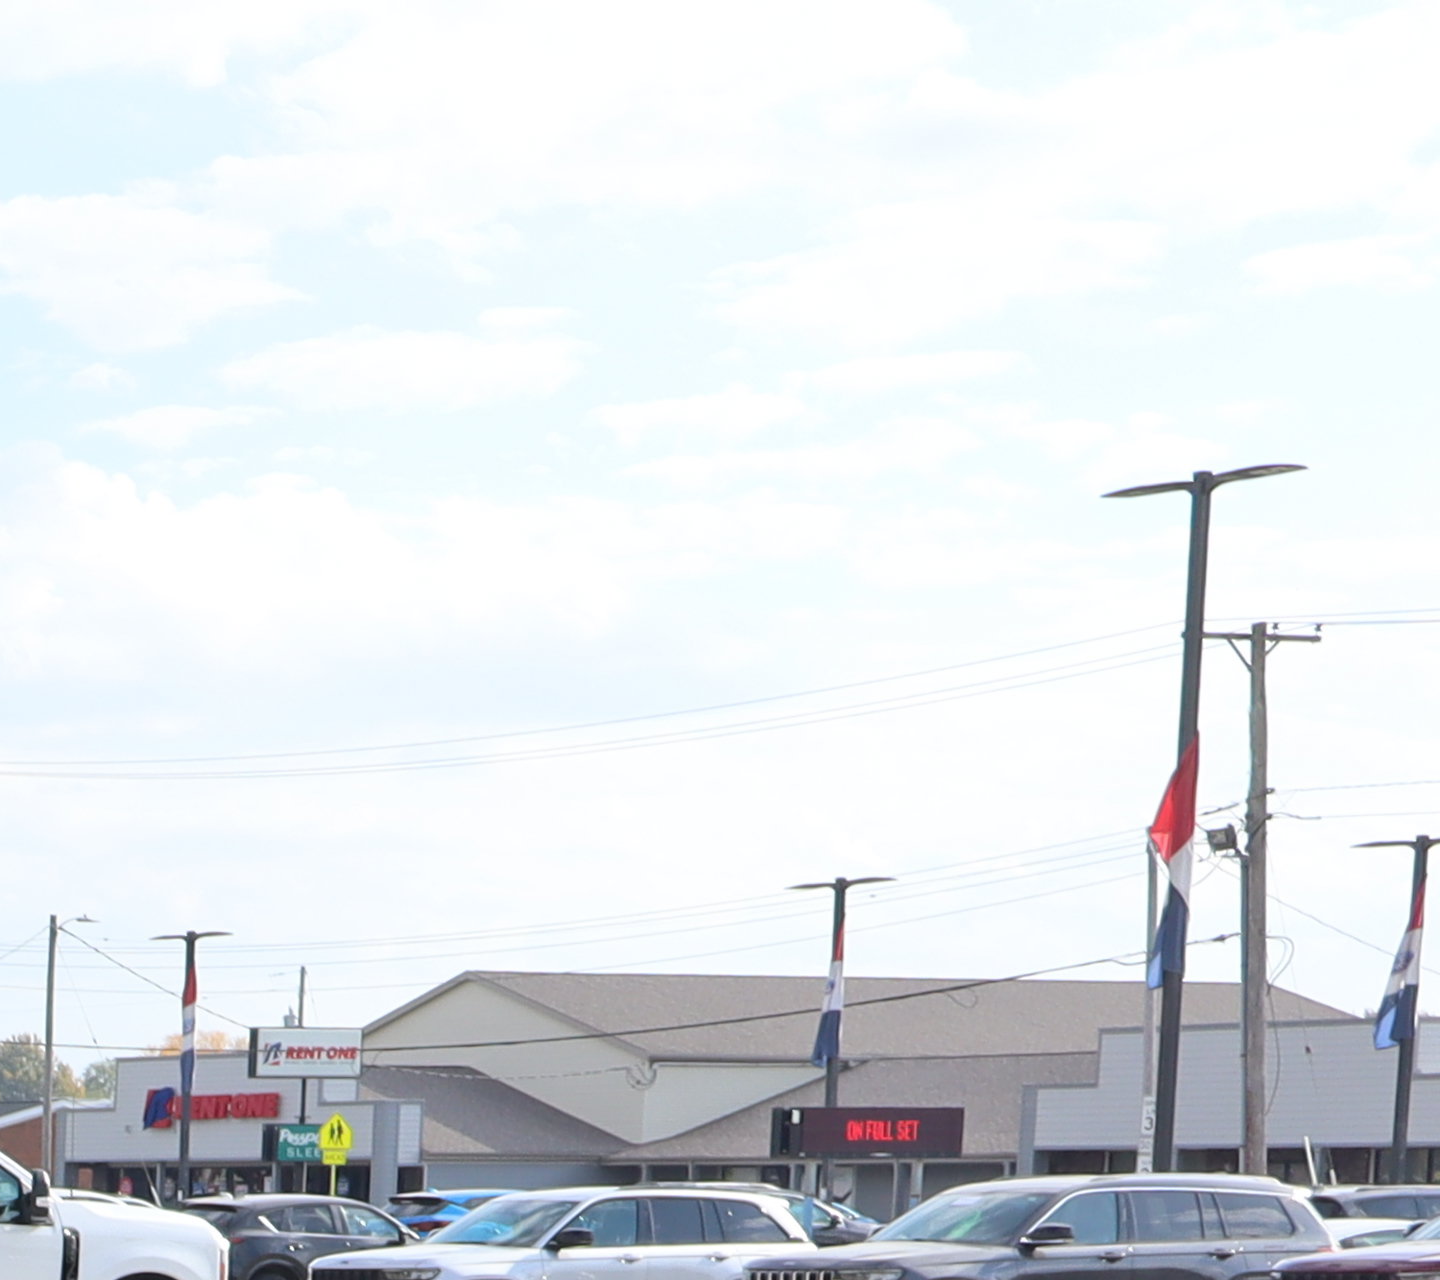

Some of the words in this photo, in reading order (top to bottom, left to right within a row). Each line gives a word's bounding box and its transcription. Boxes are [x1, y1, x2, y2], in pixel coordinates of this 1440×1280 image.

[285, 1046, 324, 1060] RENT
[326, 1046, 358, 1060] ONE
[231, 1093, 279, 1118] ONE
[846, 1121, 862, 1141] ON
[865, 1121, 893, 1141] FULL
[896, 1120, 919, 1141] SET
